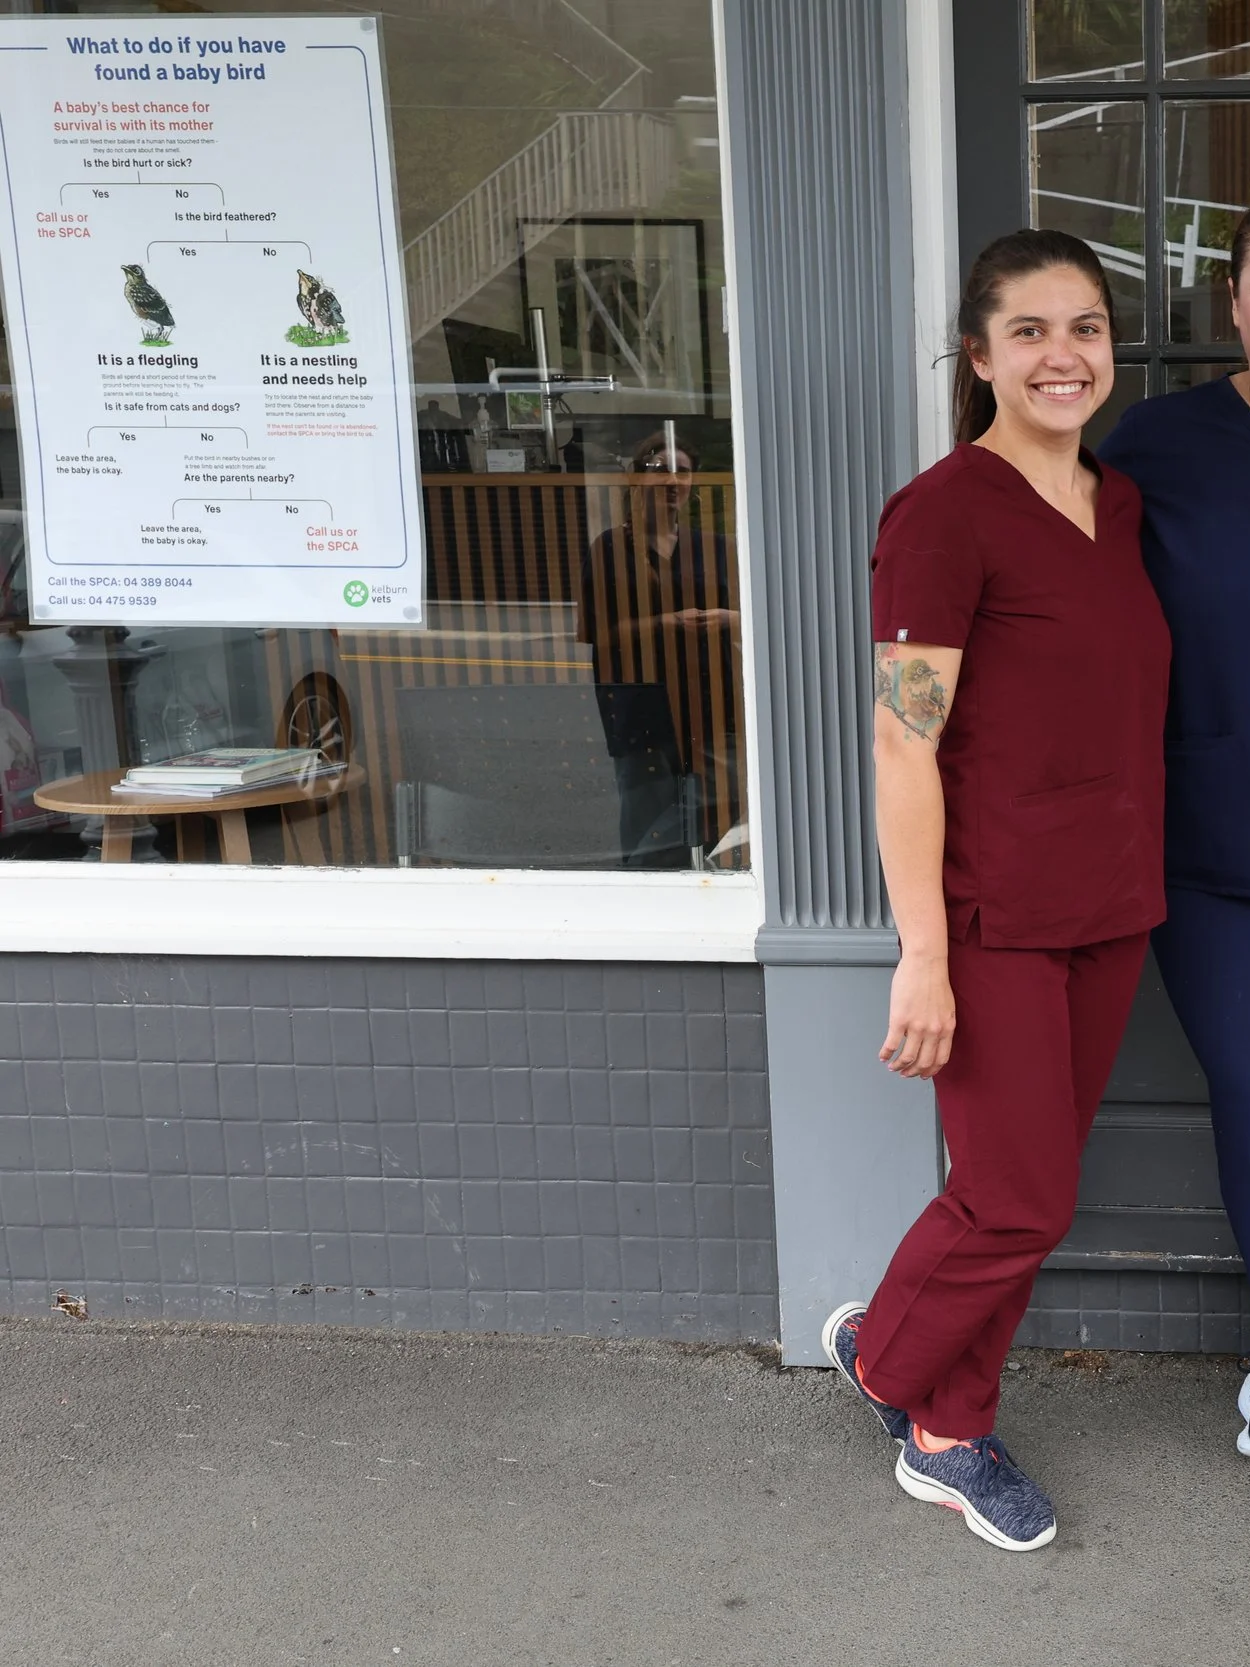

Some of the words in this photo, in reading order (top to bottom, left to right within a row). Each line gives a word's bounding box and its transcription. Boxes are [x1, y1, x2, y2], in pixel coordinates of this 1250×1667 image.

[66, 37, 119, 54] What
[123, 38, 143, 54] to
[148, 37, 173, 54] do
[177, 36, 191, 53] if
[196, 40, 233, 58] you
[238, 36, 286, 53] have
[94, 64, 151, 80] found
[156, 68, 168, 80] a
[172, 63, 221, 84] baby
[226, 63, 265, 80] bird
[54, 101, 63, 113] A
[66, 101, 108, 116] baby’s
[112, 101, 140, 113] best
[143, 101, 189, 113] chance
[192, 101, 210, 113] for
[54, 119, 102, 131] survival
[106, 119, 117, 131] is
[120, 119, 146, 131] with
[150, 119, 165, 131] its
[169, 119, 214, 131] mother
[83, 158, 92, 167] Is
[94, 158, 109, 167] the
[112, 158, 130, 167] bird
[132, 158, 152, 167] hurt
[167, 158, 192, 167] sick?
[92, 189, 109, 198] Yes
[175, 189, 189, 198] No
[36, 212, 58, 223] Call
[60, 214, 74, 222] us
[77, 214, 88, 222] or
[175, 212, 183, 221] Is
[186, 212, 201, 221] the
[203, 212, 222, 221] bird
[224, 212, 276, 221] feathered?
[38, 228, 56, 238] the
[59, 227, 91, 238] SPCA
[179, 247, 196, 256] Yes
[263, 248, 276, 256] No
[98, 354, 108, 365] It
[111, 354, 123, 366] is
[127, 357, 134, 365] a
[138, 354, 198, 369] fledgling
[261, 354, 271, 366] It
[274, 354, 286, 366] is
[290, 357, 298, 366] a
[302, 355, 357, 369] nestling
[263, 373, 288, 385] and
[292, 373, 334, 385] needs
[338, 374, 367, 388] help
[105, 402, 113, 411] Is
[115, 402, 122, 410] it
[124, 402, 144, 411] safe
[146, 402, 168, 411] from
[170, 403, 190, 411] cats
[192, 403, 209, 411] and
[211, 402, 240, 414] dogs?
[119, 432, 136, 441] Yes
[201, 433, 214, 441] No
[56, 454, 79, 462] Leave
[81, 454, 94, 462] the
[71, 466, 91, 475] baby
[101, 467, 123, 476] okay.
[184, 473, 200, 482] Are
[202, 473, 217, 482] the
[220, 474, 255, 484] parents
[257, 474, 295, 484] nearby?
[204, 505, 221, 513] Yes
[286, 505, 299, 514] No
[306, 526, 327, 536] Call
[346, 529, 357, 537] or
[156, 537, 176, 546] baby
[187, 537, 208, 546] okay.
[307, 541, 325, 551] the
[328, 541, 359, 551] SPCA
[48, 577, 67, 586] Call
[70, 577, 86, 586] the
[89, 577, 121, 586] SPCA:
[124, 577, 138, 587] 04
[141, 577, 162, 587] 389
[164, 578, 192, 587] 8044
[372, 585, 407, 594] kelburn
[49, 595, 68, 605] Call
[89, 596, 102, 605] 04
[105, 596, 125, 605] 475
[128, 596, 157, 606] 9539
[372, 594, 392, 603] vets
